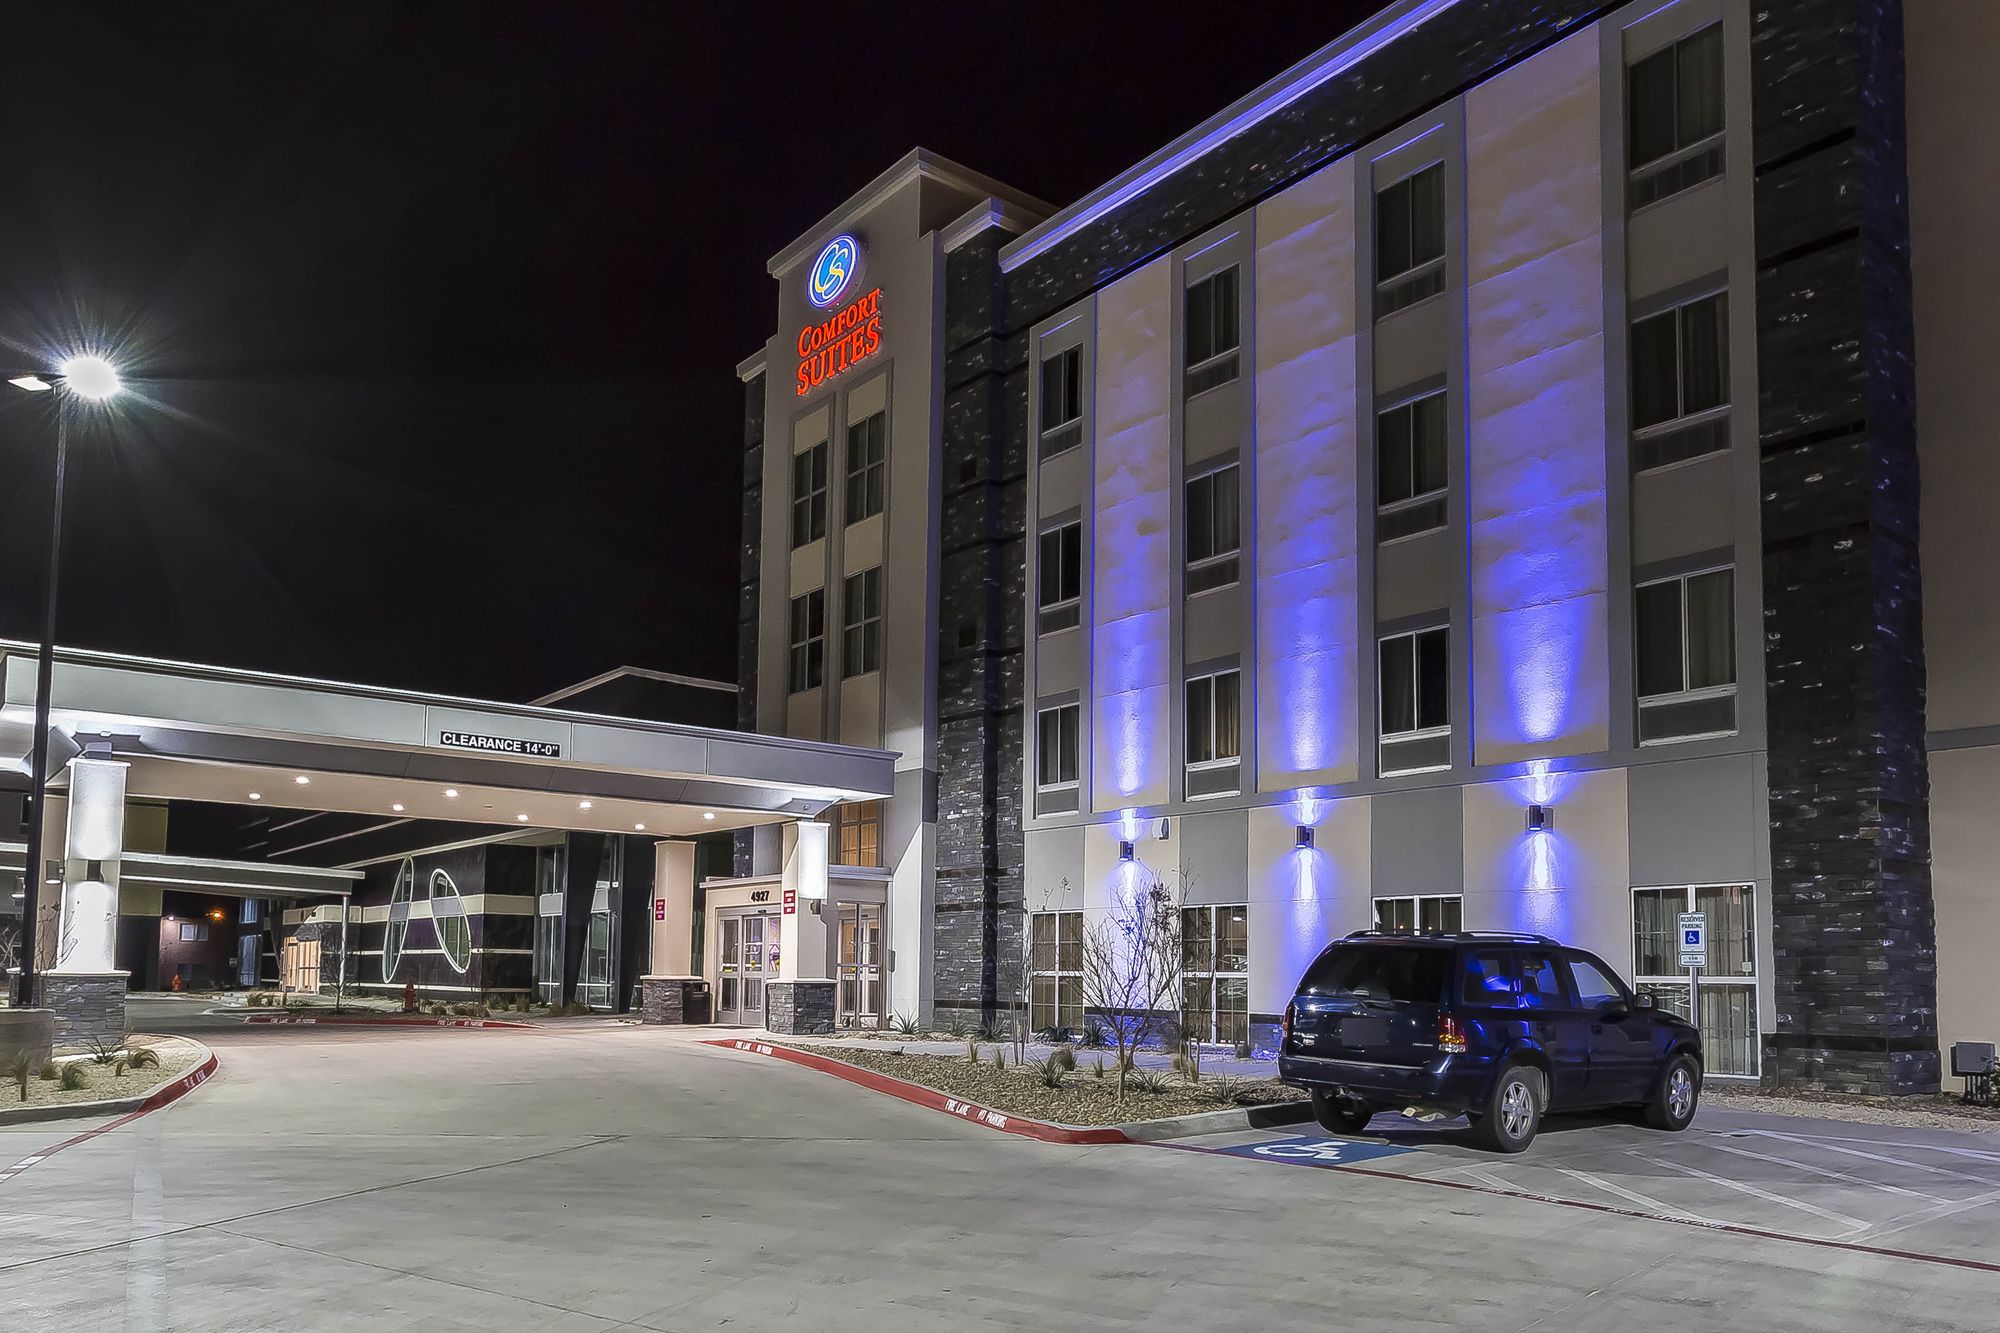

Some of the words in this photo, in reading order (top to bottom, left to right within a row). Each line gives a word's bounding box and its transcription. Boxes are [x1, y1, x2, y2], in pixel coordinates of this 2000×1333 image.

[798, 288, 880, 358] COMFORT
[797, 317, 880, 396] SUITES
[442, 733, 521, 752] CLEARANCE
[751, 891, 770, 902] 4927
